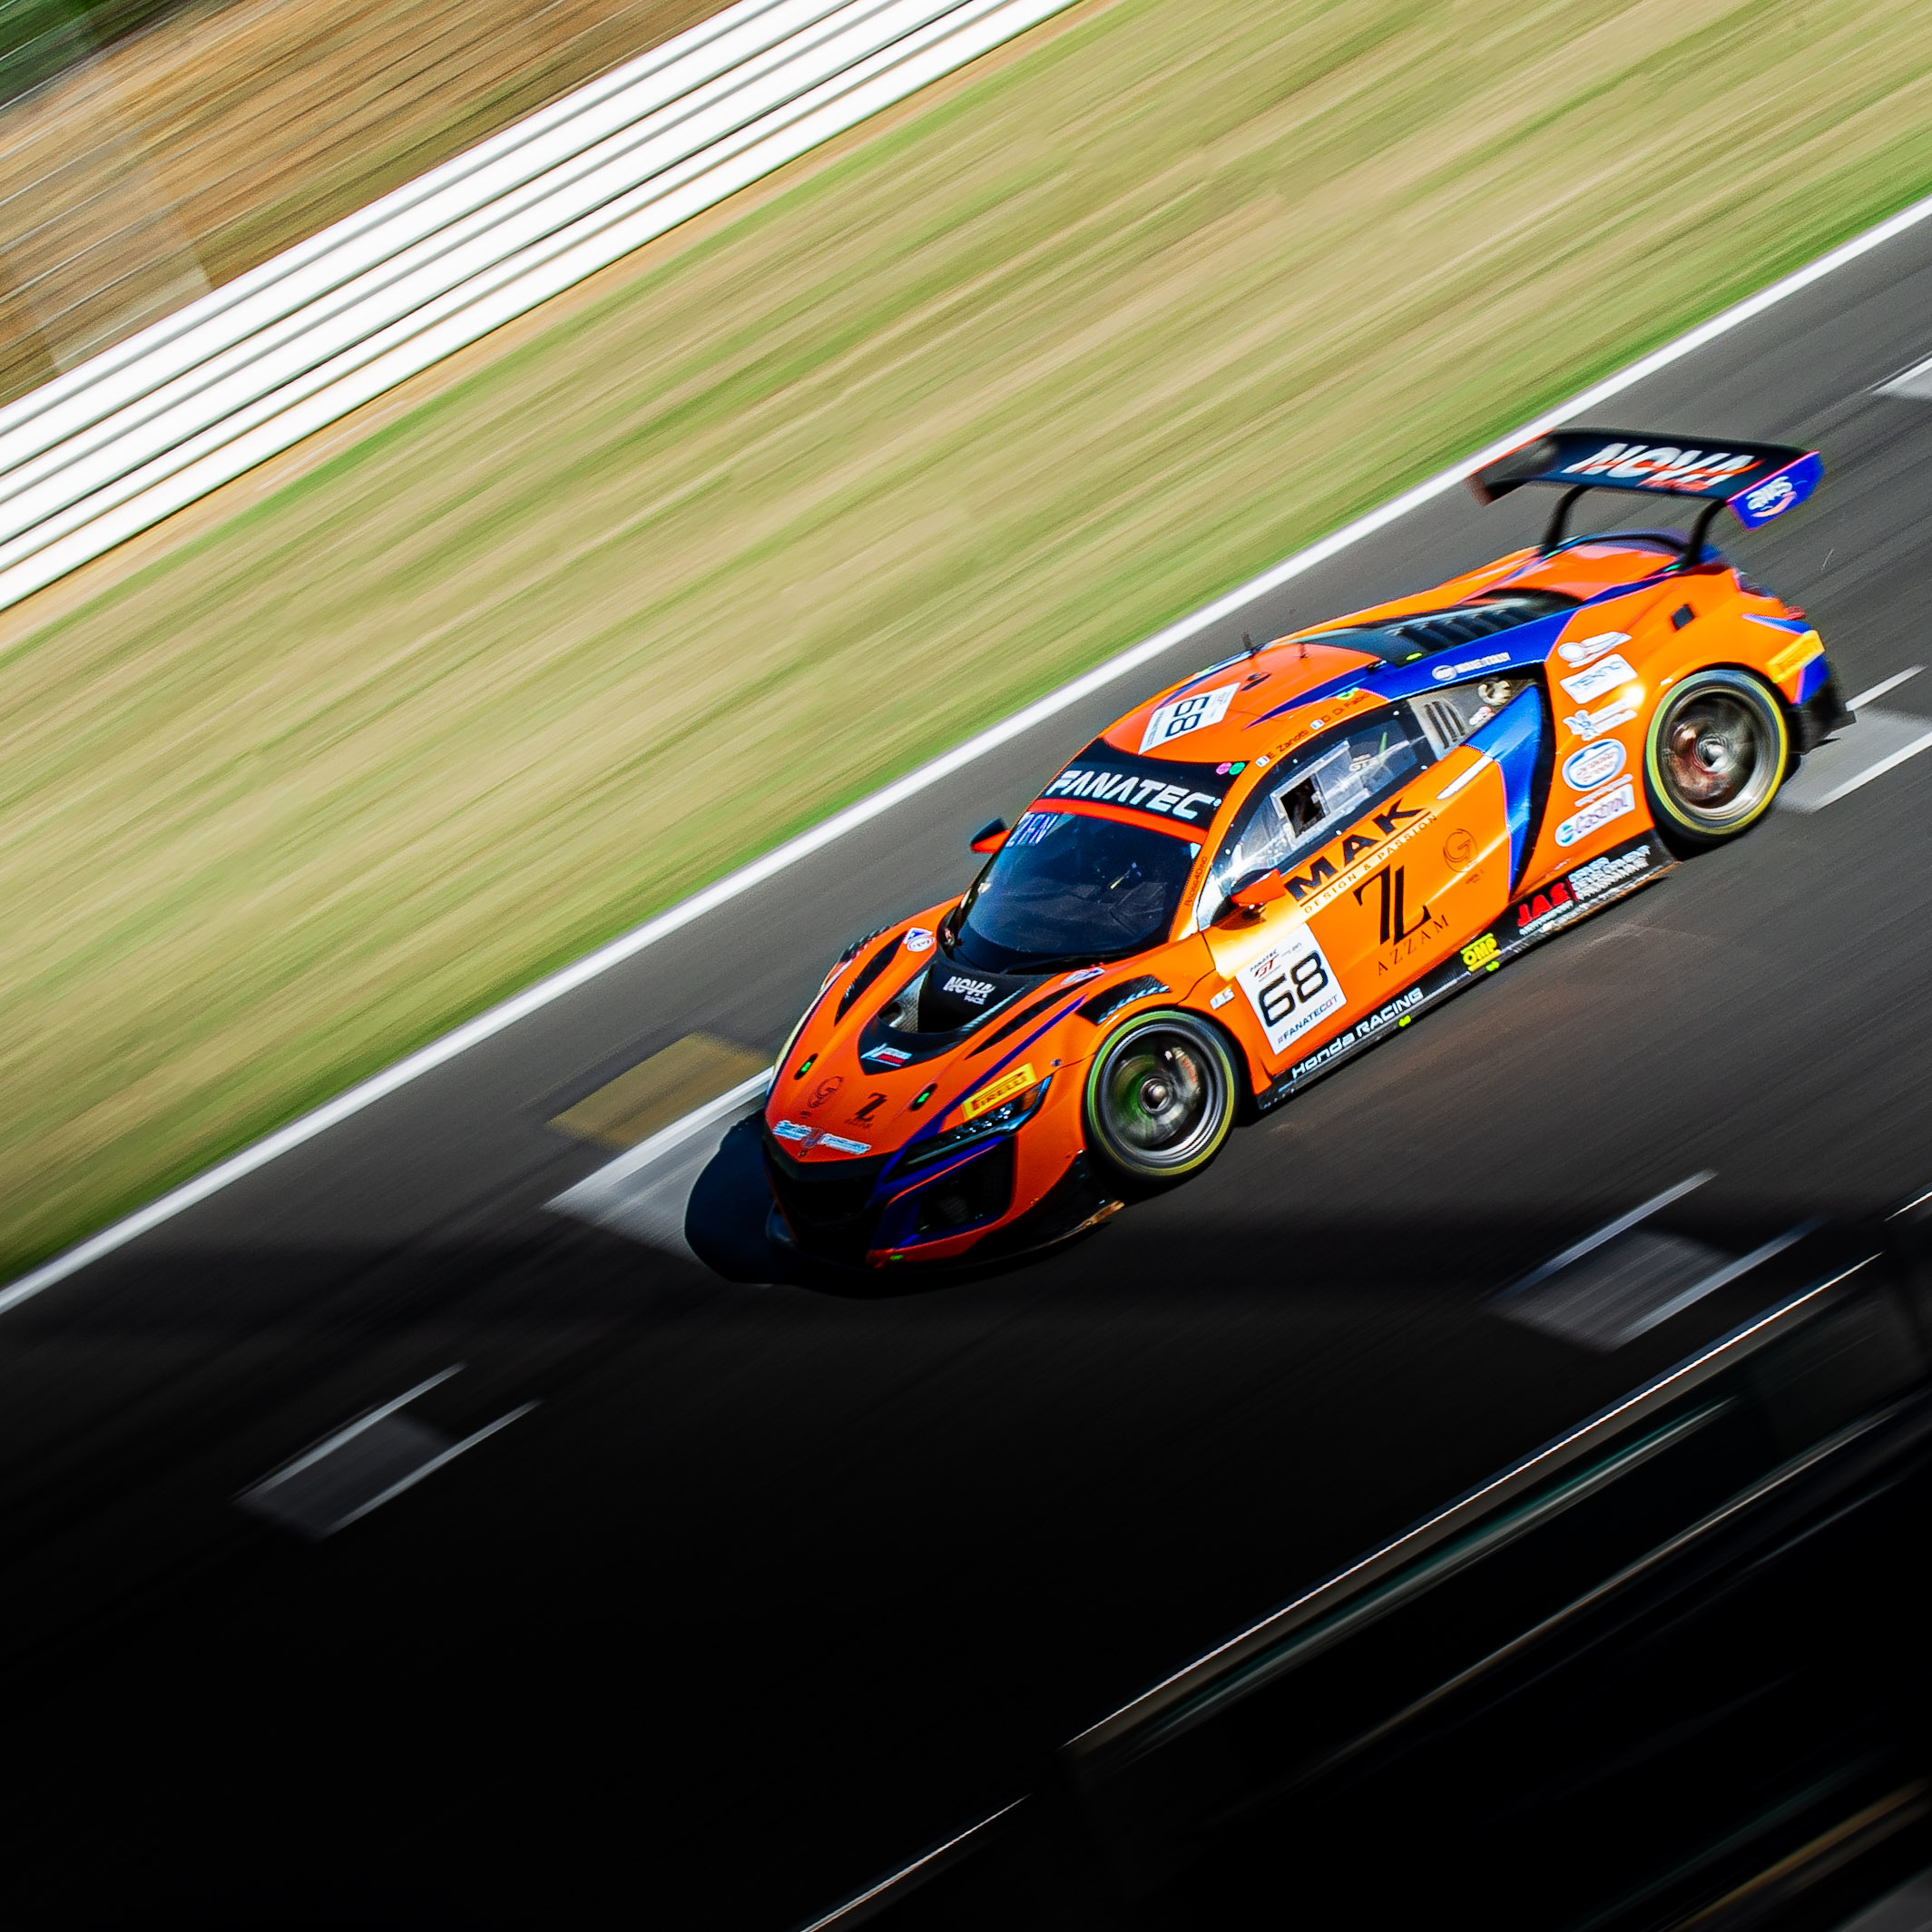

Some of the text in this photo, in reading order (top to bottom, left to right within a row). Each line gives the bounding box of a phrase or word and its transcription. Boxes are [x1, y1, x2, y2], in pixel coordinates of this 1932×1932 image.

[1560, 443, 1755, 486] NOVA
[1164, 696, 1211, 738] 68
[1044, 770, 1216, 820] FANATEC
[1284, 799, 1427, 902] MAK
[1304, 814, 1437, 914] DESIGN & PASSION
[1517, 882, 1571, 927] JAS
[1377, 915, 1450, 976] AZZAM
[1462, 937, 1498, 966] OMP
[943, 976, 996, 998] NOVA
[1259, 950, 1329, 1027] 68
[1278, 994, 1339, 1044] #FANATECGT
[1291, 986, 1424, 1079] Honda RACING
[972, 1071, 1026, 1111] PIRELLI
